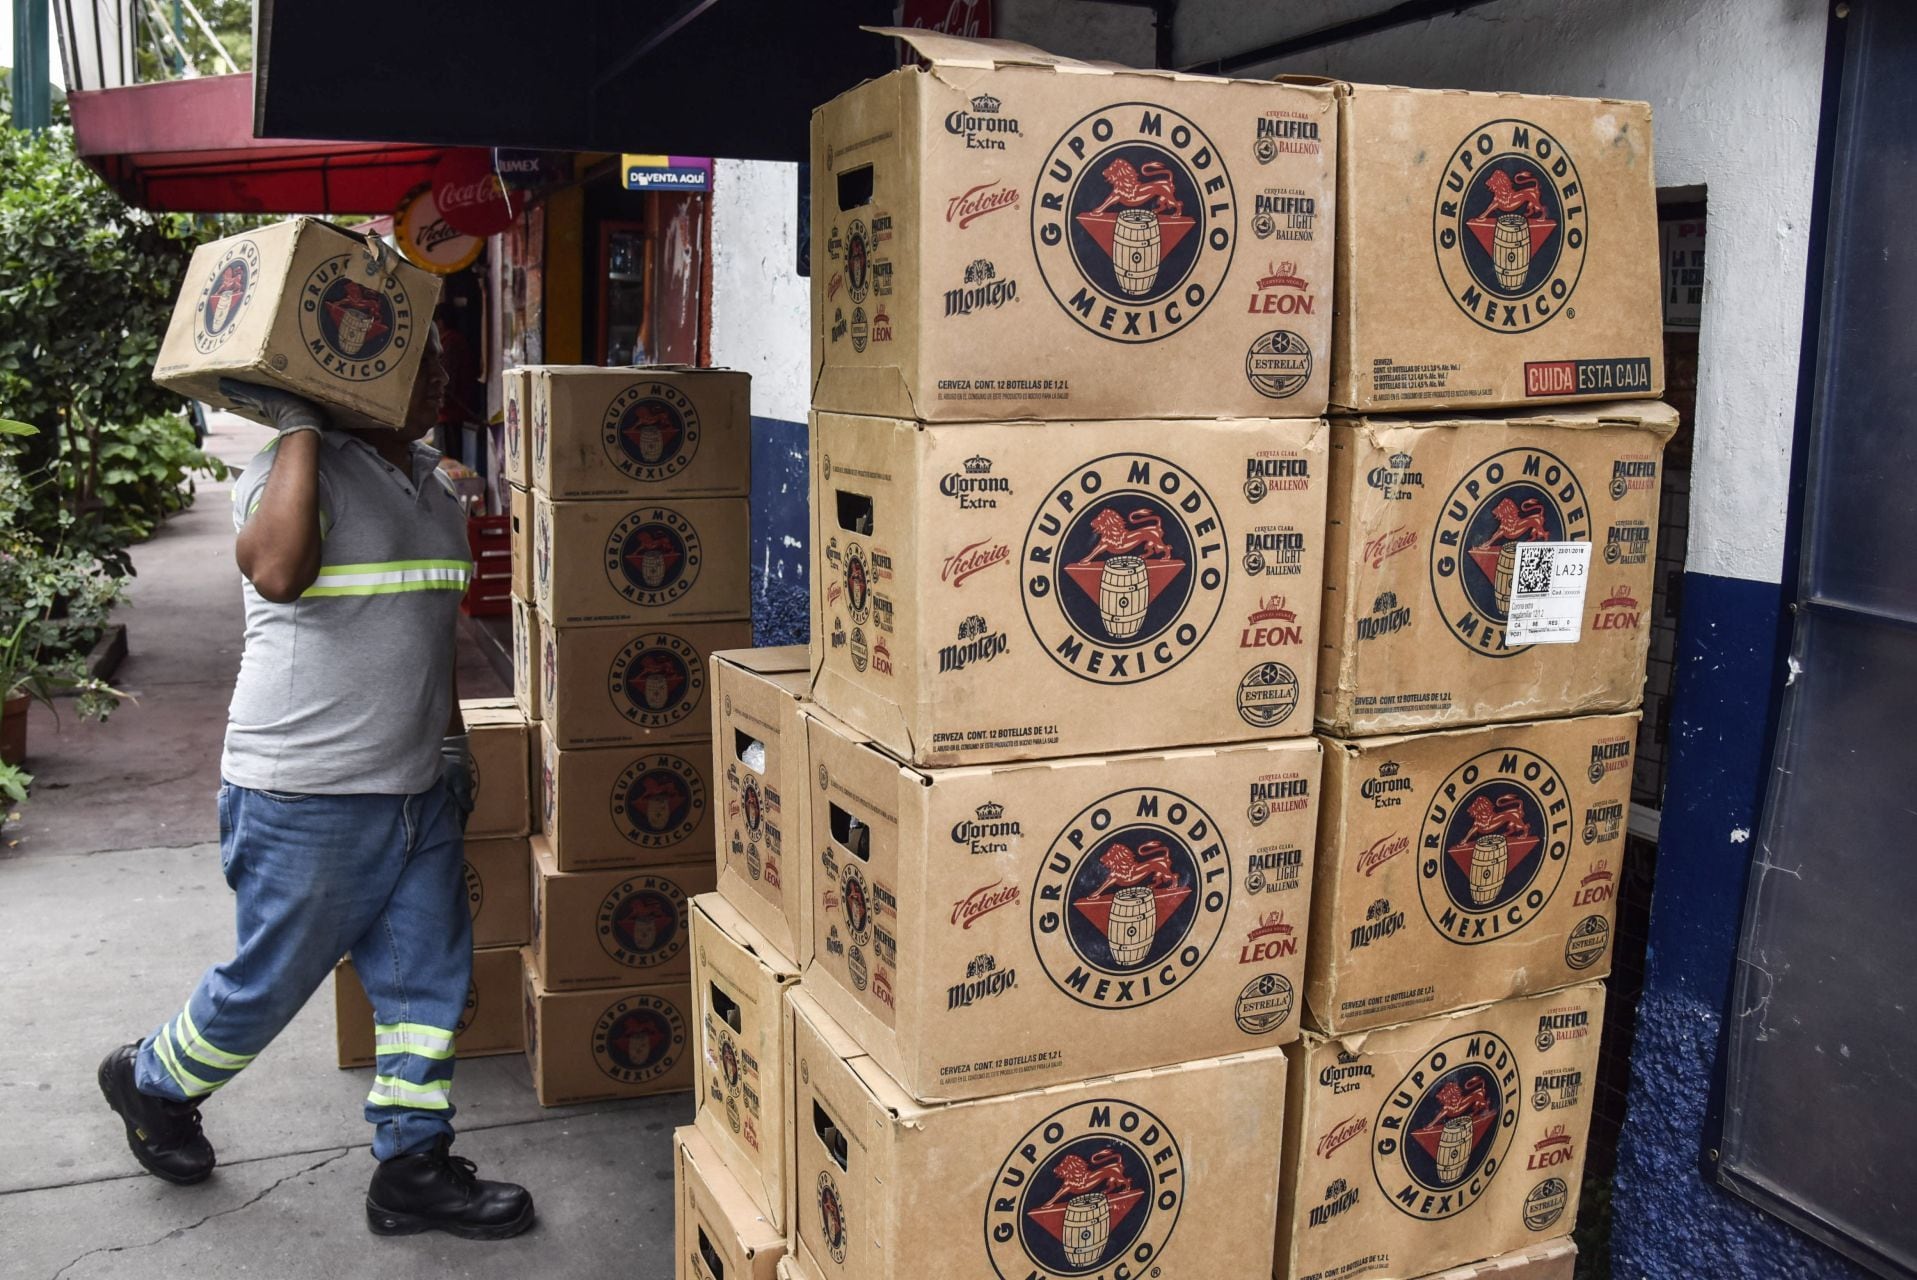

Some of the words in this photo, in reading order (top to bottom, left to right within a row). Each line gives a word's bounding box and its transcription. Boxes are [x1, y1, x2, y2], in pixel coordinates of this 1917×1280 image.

[944, 110, 1019, 137] Corona
[966, 133, 1005, 150] Extra
[1257, 117, 1318, 140] PACIFICO
[646, 173, 678, 183] VENTA
[679, 171, 705, 184] AQUÍ
[1041, 118, 1113, 246] GRUPO
[1139, 111, 1229, 251] MODELO
[1440, 133, 1494, 249] GRUPO
[1512, 126, 1583, 249] MODELO
[946, 179, 1019, 230] Victoria
[1255, 194, 1315, 215] PACIFICO
[198, 250, 233, 312] GRUPO
[240, 244, 258, 306] MODELO
[944, 278, 1016, 318] Montejo
[385, 277, 409, 348] ODELO
[1069, 283, 1205, 335] MEXICO
[1461, 278, 1567, 327] MEXICO
[197, 323, 235, 350] MEXICO
[310, 339, 386, 377] MEXICO
[1529, 367, 1573, 392] CUIDA
[1578, 365, 1612, 389] ESTA
[1616, 363, 1648, 387] CAJA
[938, 380, 971, 389] CERVEZA
[974, 380, 995, 389] CONT.
[997, 380, 1005, 389] 12
[1006, 380, 1042, 389] BOTELLAS
[1043, 380, 1053, 389] DE
[606, 389, 638, 444] GRUPO
[650, 384, 697, 441] MODELO
[620, 455, 686, 479] MEXICO
[939, 472, 1010, 499] Corona
[1247, 458, 1307, 478] PACIFICO
[959, 494, 997, 509] Extra
[1437, 462, 1504, 577] GRUPO
[1522, 454, 1586, 542] MODEL
[609, 515, 640, 569] GRUPO
[652, 510, 698, 565] MODELO
[1029, 470, 1102, 598] GRUPO
[1127, 461, 1221, 591] MODELO
[1246, 533, 1303, 553] PACIFICO
[941, 537, 1010, 588] Victoria
[1555, 563, 1584, 576] LA23
[622, 580, 688, 603] MEXICO
[612, 640, 644, 693] GRUPO
[656, 636, 701, 688] MODELO
[938, 631, 1007, 674] Montejo
[1056, 623, 1197, 677] MEXICO
[626, 702, 691, 725] MEXICO
[933, 732, 964, 743] CERVEZA
[967, 730, 988, 740] CONT.
[989, 729, 997, 739] 12
[998, 726, 1032, 738] BOTELLAS
[1033, 726, 1042, 735] DE
[614, 762, 646, 815] GRUPO
[658, 757, 703, 808] MODELO
[1250, 779, 1308, 803] PACIFICO
[1361, 777, 1411, 800] Corona
[1374, 795, 1401, 809] Extra
[628, 822, 692, 845] MEXICO
[951, 820, 1021, 845] Corona
[1423, 765, 1479, 879] GRUPO
[1498, 753, 1568, 861] MODELO
[971, 839, 1008, 855] Extra
[1039, 808, 1112, 934] GRUPO
[1136, 795, 1225, 913] MODELO
[1248, 849, 1302, 873] PACIFICO
[1356, 831, 1409, 877] Victoria
[951, 877, 1020, 930] Victoria
[1439, 889, 1543, 938] MEXICO
[1350, 911, 1404, 951] Montejo
[947, 967, 1016, 1011] Montejo
[1064, 945, 1200, 1002] MEXICO
[940, 1064, 971, 1076] CERVEZA
[974, 1061, 994, 1071] CONT.
[995, 1059, 1003, 1068] 12
[1003, 1054, 1037, 1067] BOTELLAS
[1038, 1052, 1047, 1061] DE
[1319, 1064, 1373, 1087] Corona
[1333, 1081, 1360, 1095] Extra
[1377, 1052, 1447, 1155] GRUPO
[1466, 1037, 1517, 1128] MODELO
[1316, 1112, 1367, 1160] Victoria
[993, 1122, 1064, 1243] GRUPO
[1088, 1105, 1177, 1211] MODELO
[1396, 1158, 1496, 1214] MEXICO
[1309, 1187, 1359, 1229] Montejo
